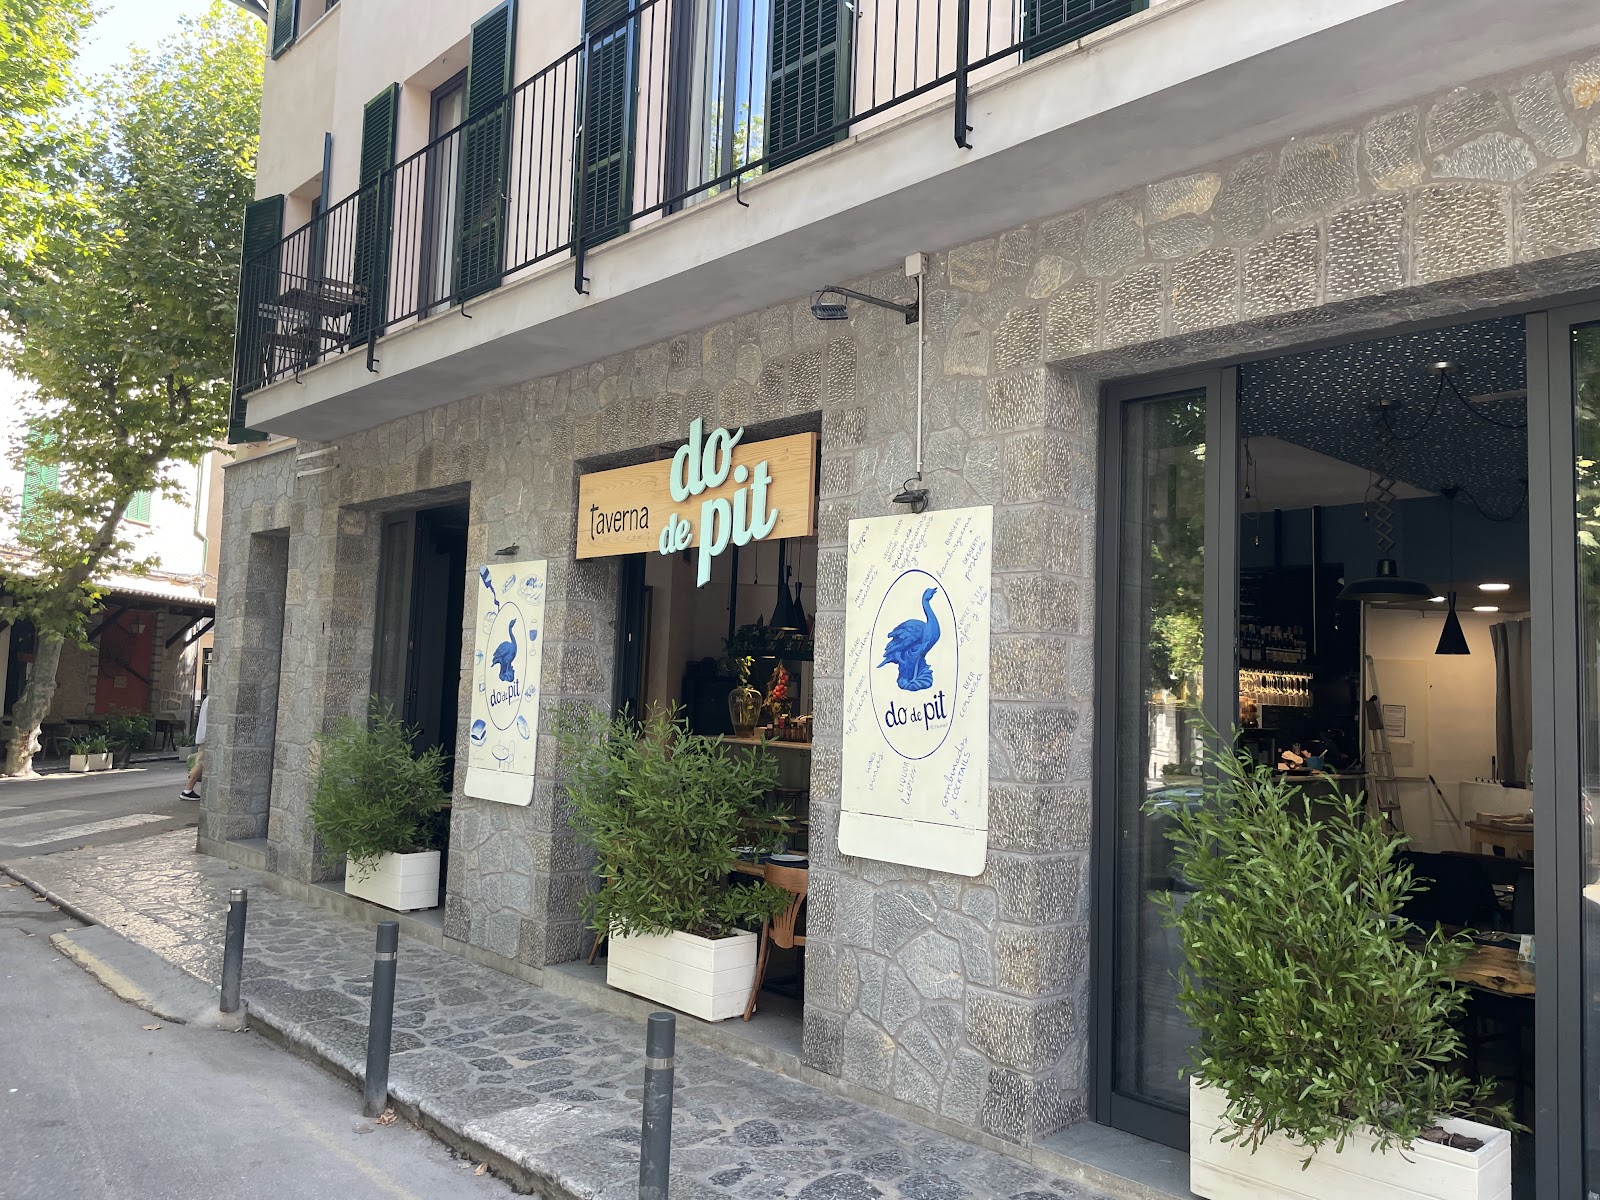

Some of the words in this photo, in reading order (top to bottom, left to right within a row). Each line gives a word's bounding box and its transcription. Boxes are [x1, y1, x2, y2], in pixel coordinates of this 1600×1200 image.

[669, 417, 745, 503] do
[590, 504, 649, 541] taverna
[658, 512, 693, 556] de
[696, 460, 779, 588] pit
[850, 525, 870, 554] tapas
[892, 527, 912, 572] opciones
[962, 536, 981, 565] DESSERTS
[965, 541, 986, 582] postres
[855, 588, 864, 604] MAIN
[957, 606, 971, 629] COFFEE
[974, 585, 984, 598] TEA
[849, 630, 870, 677] ensaladas
[490, 689, 502, 707] do
[508, 679, 520, 706] pit
[960, 672, 983, 718] cerveza
[963, 671, 975, 690] BEER
[845, 688, 868, 736] refrescos
[885, 701, 907, 728] do
[910, 707, 922, 723] de
[923, 690, 947, 731] pit
[866, 752, 876, 773] WINES
[869, 752, 883, 790] vinos
[898, 761, 910, 793] LIQUOR
[942, 736, 968, 807] combinados
[952, 752, 971, 800] COCKTAILS
[901, 765, 917, 805] licores
[949, 808, 960, 820] y
